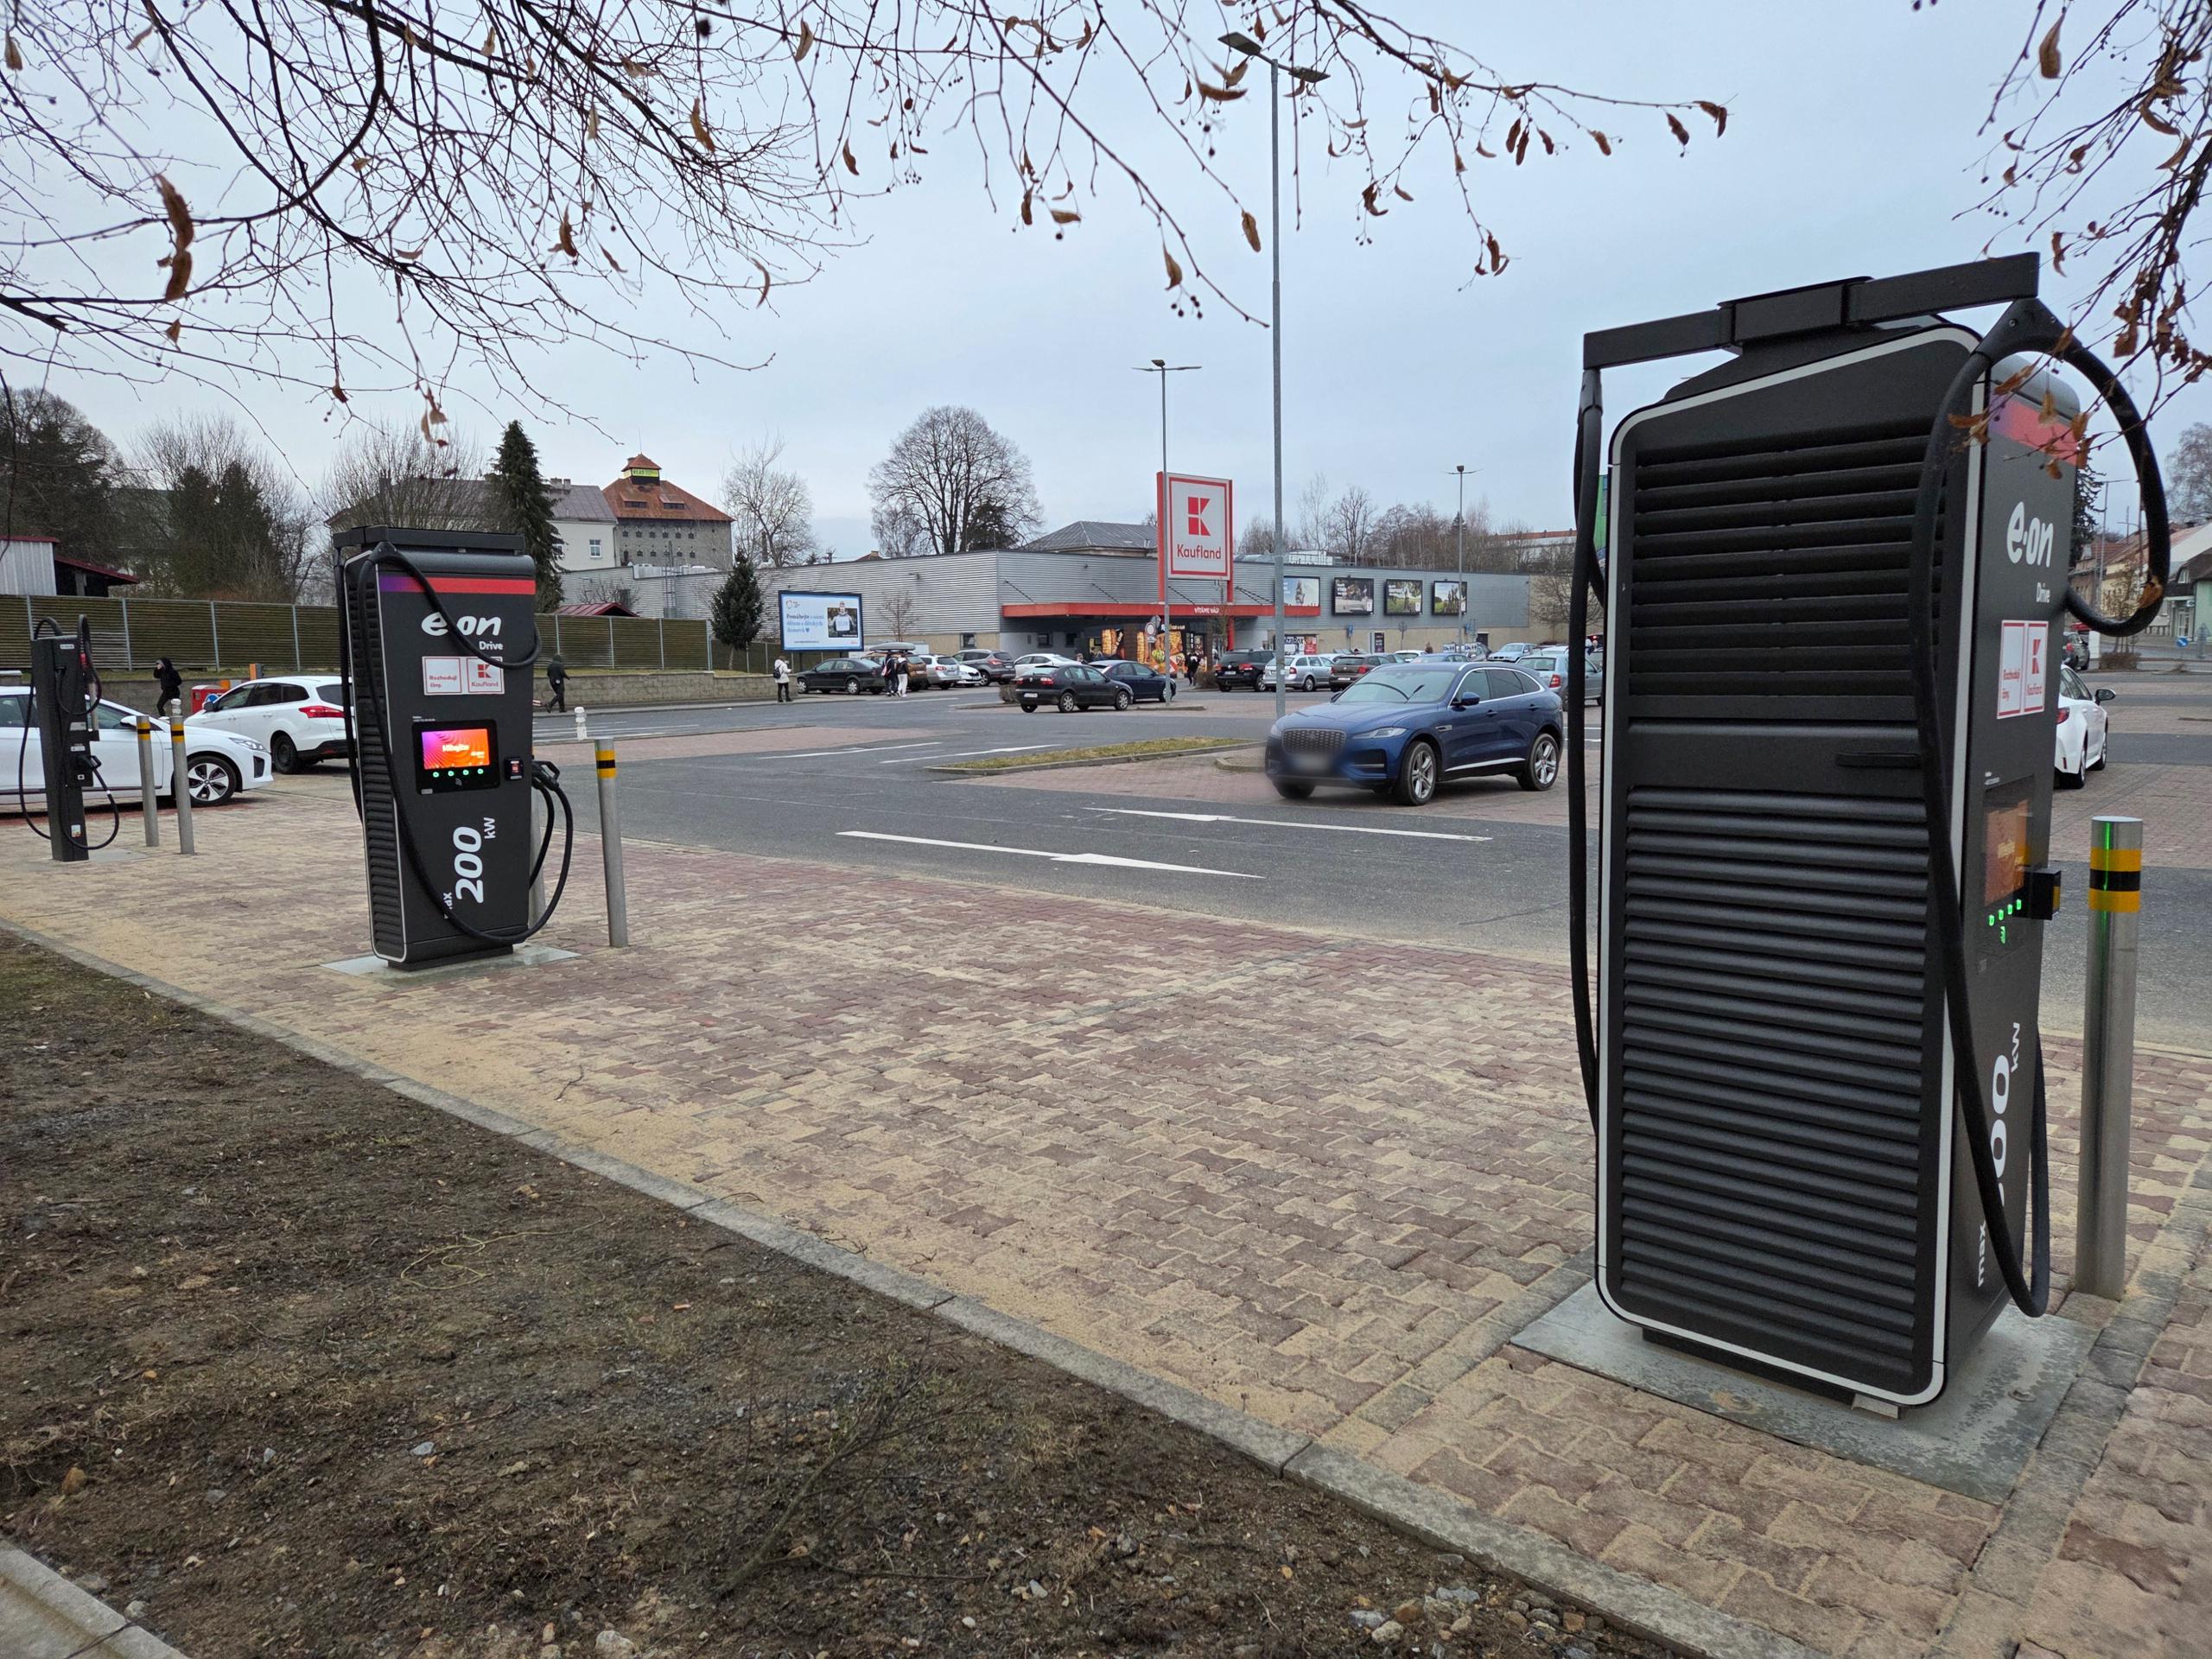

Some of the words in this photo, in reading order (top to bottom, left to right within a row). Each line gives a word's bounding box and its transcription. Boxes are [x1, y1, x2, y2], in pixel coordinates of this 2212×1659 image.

[1177, 543, 1222, 560] Kaufland
[2036, 582, 2050, 603] Drive
[479, 640, 504, 651] Drive
[483, 817, 496, 839] kW
[452, 826, 484, 904] 200
[2010, 1021, 2020, 1073] kW
[1990, 1054, 2010, 1207] 00
